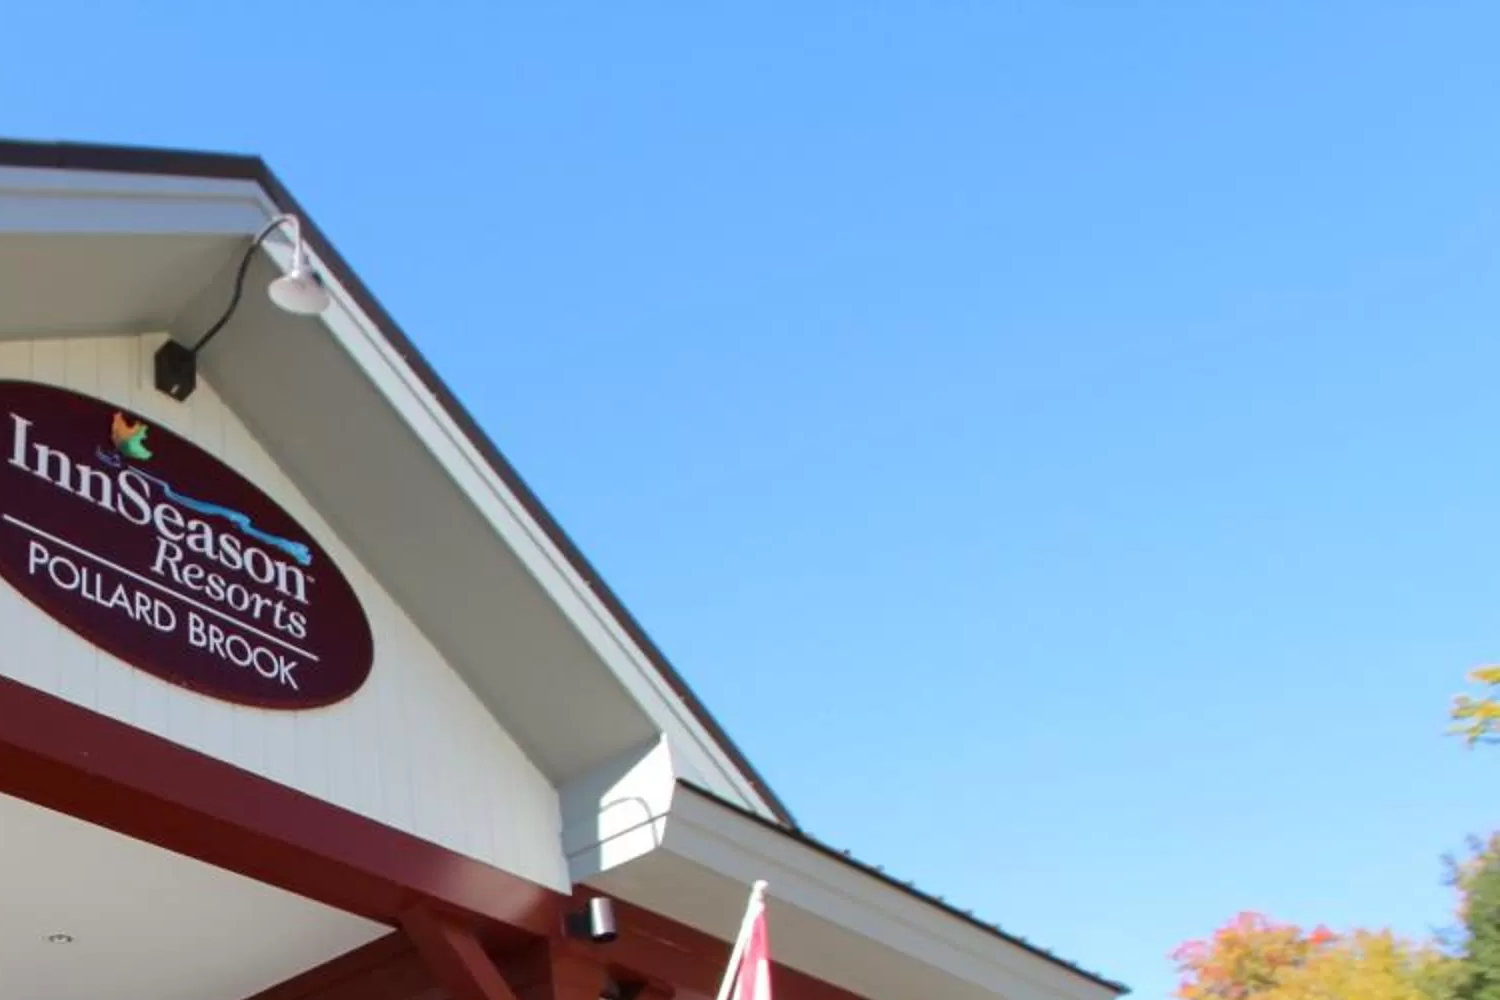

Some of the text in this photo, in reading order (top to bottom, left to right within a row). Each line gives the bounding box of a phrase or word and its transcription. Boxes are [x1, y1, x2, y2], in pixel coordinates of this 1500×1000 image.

[28, 540, 300, 690] POLLARD BROOK
[152, 536, 308, 639] Resorts
